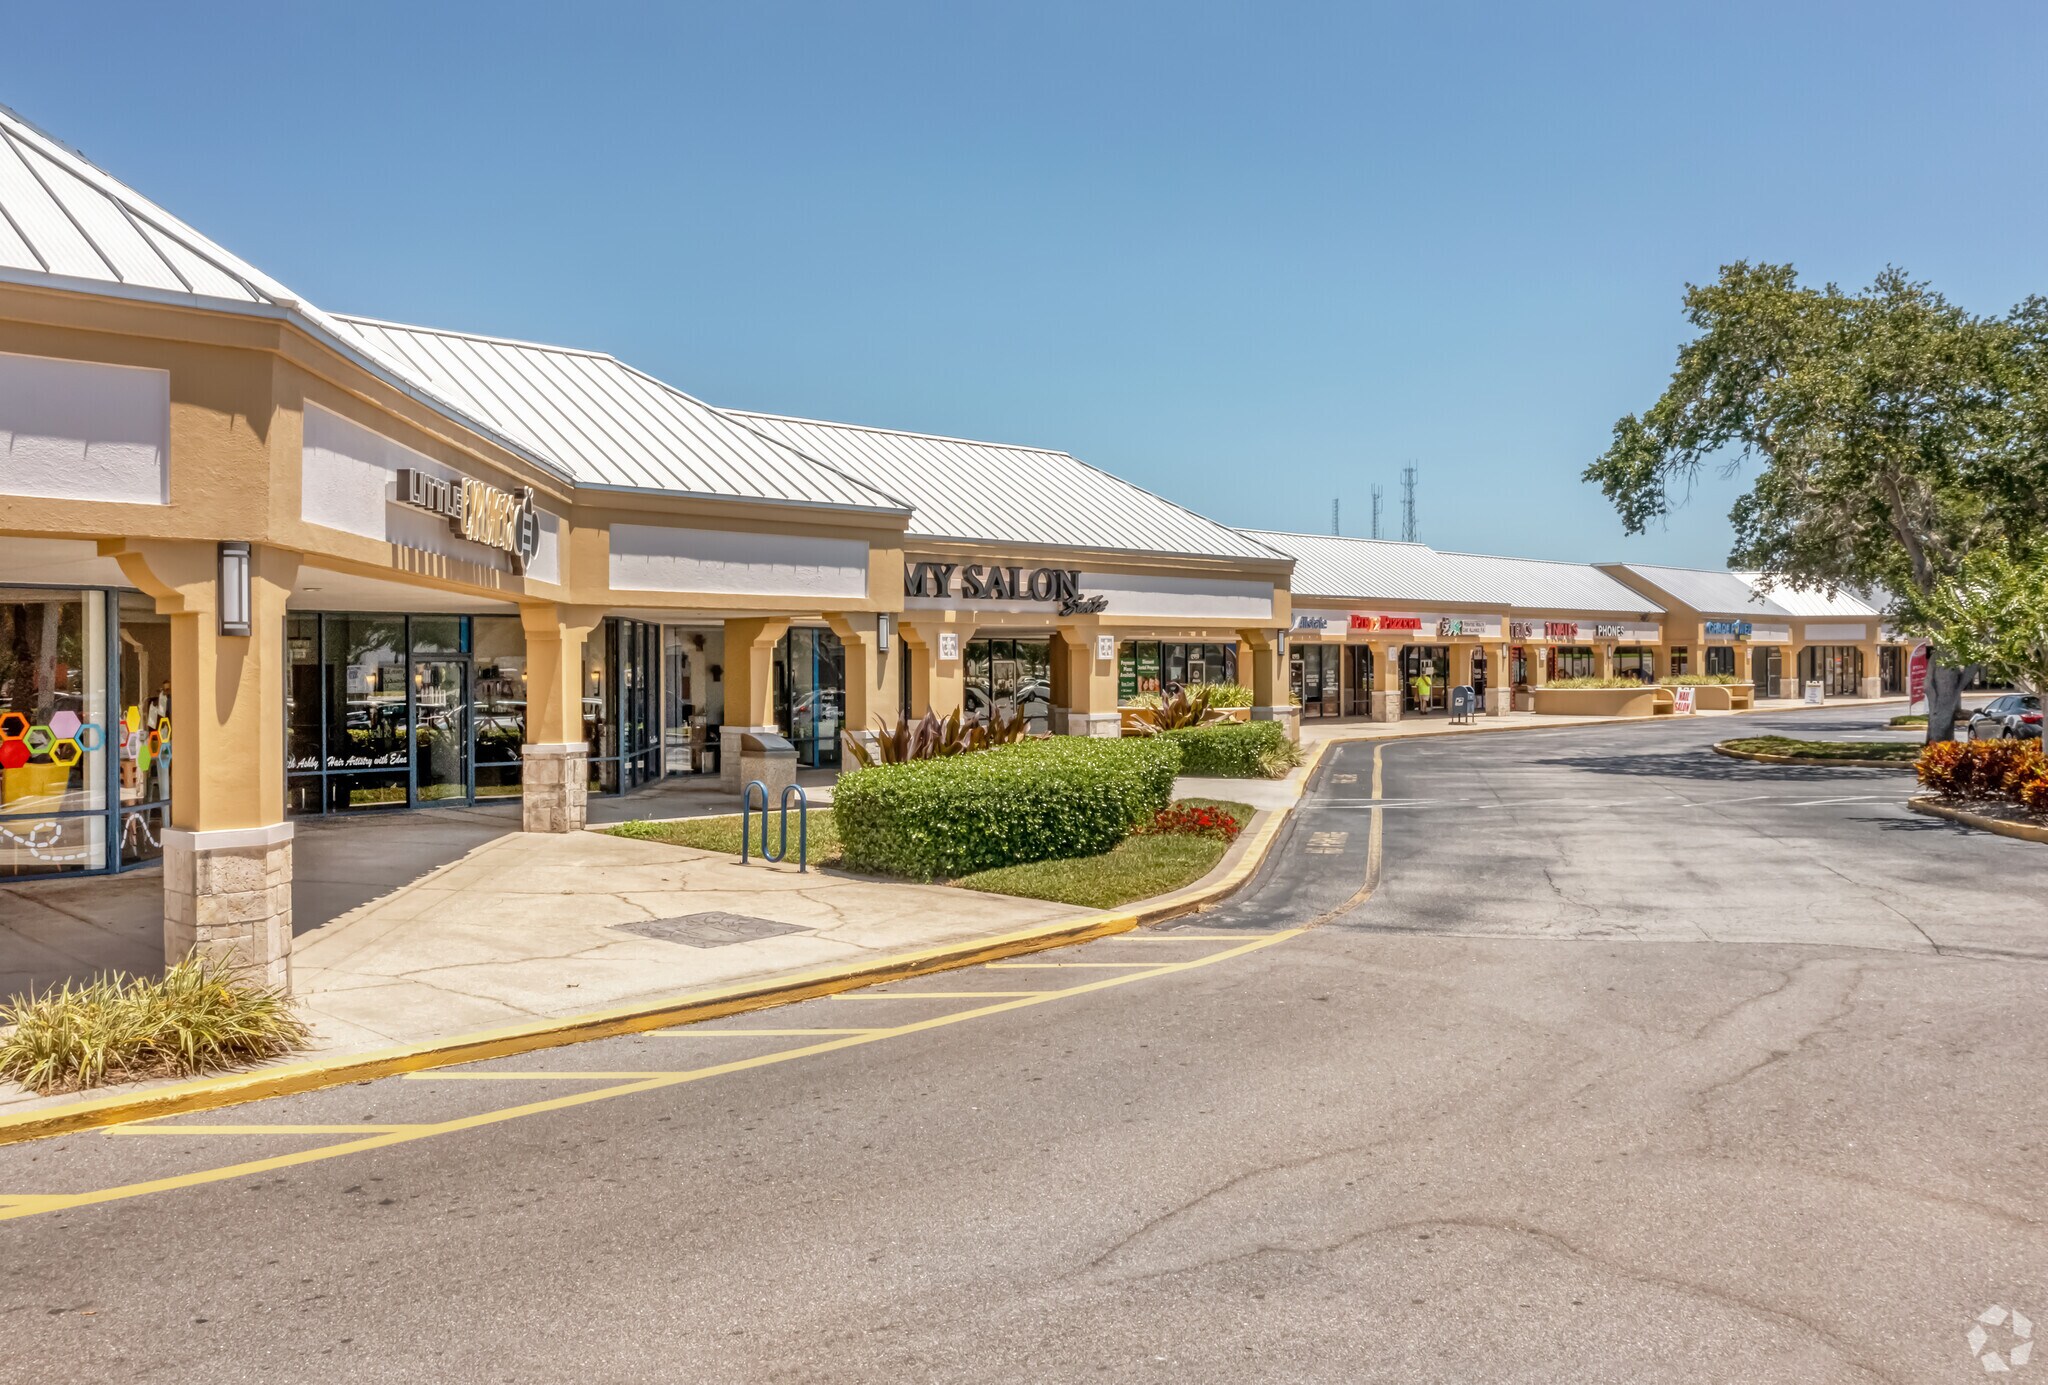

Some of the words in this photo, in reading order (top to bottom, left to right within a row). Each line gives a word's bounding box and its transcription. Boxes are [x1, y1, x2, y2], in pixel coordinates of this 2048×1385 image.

[405, 467, 462, 519] LITTLE
[904, 562, 958, 598] MY
[962, 564, 1081, 602] SALON
[1597, 624, 1625, 637] PHONES
[1679, 691, 1690, 701] NAIL
[1675, 702, 1691, 712] SALON
[296, 756, 319, 770] Ashby
[327, 756, 344, 767] Hair
[345, 755, 373, 767] Artistry
[374, 753, 388, 765] with
